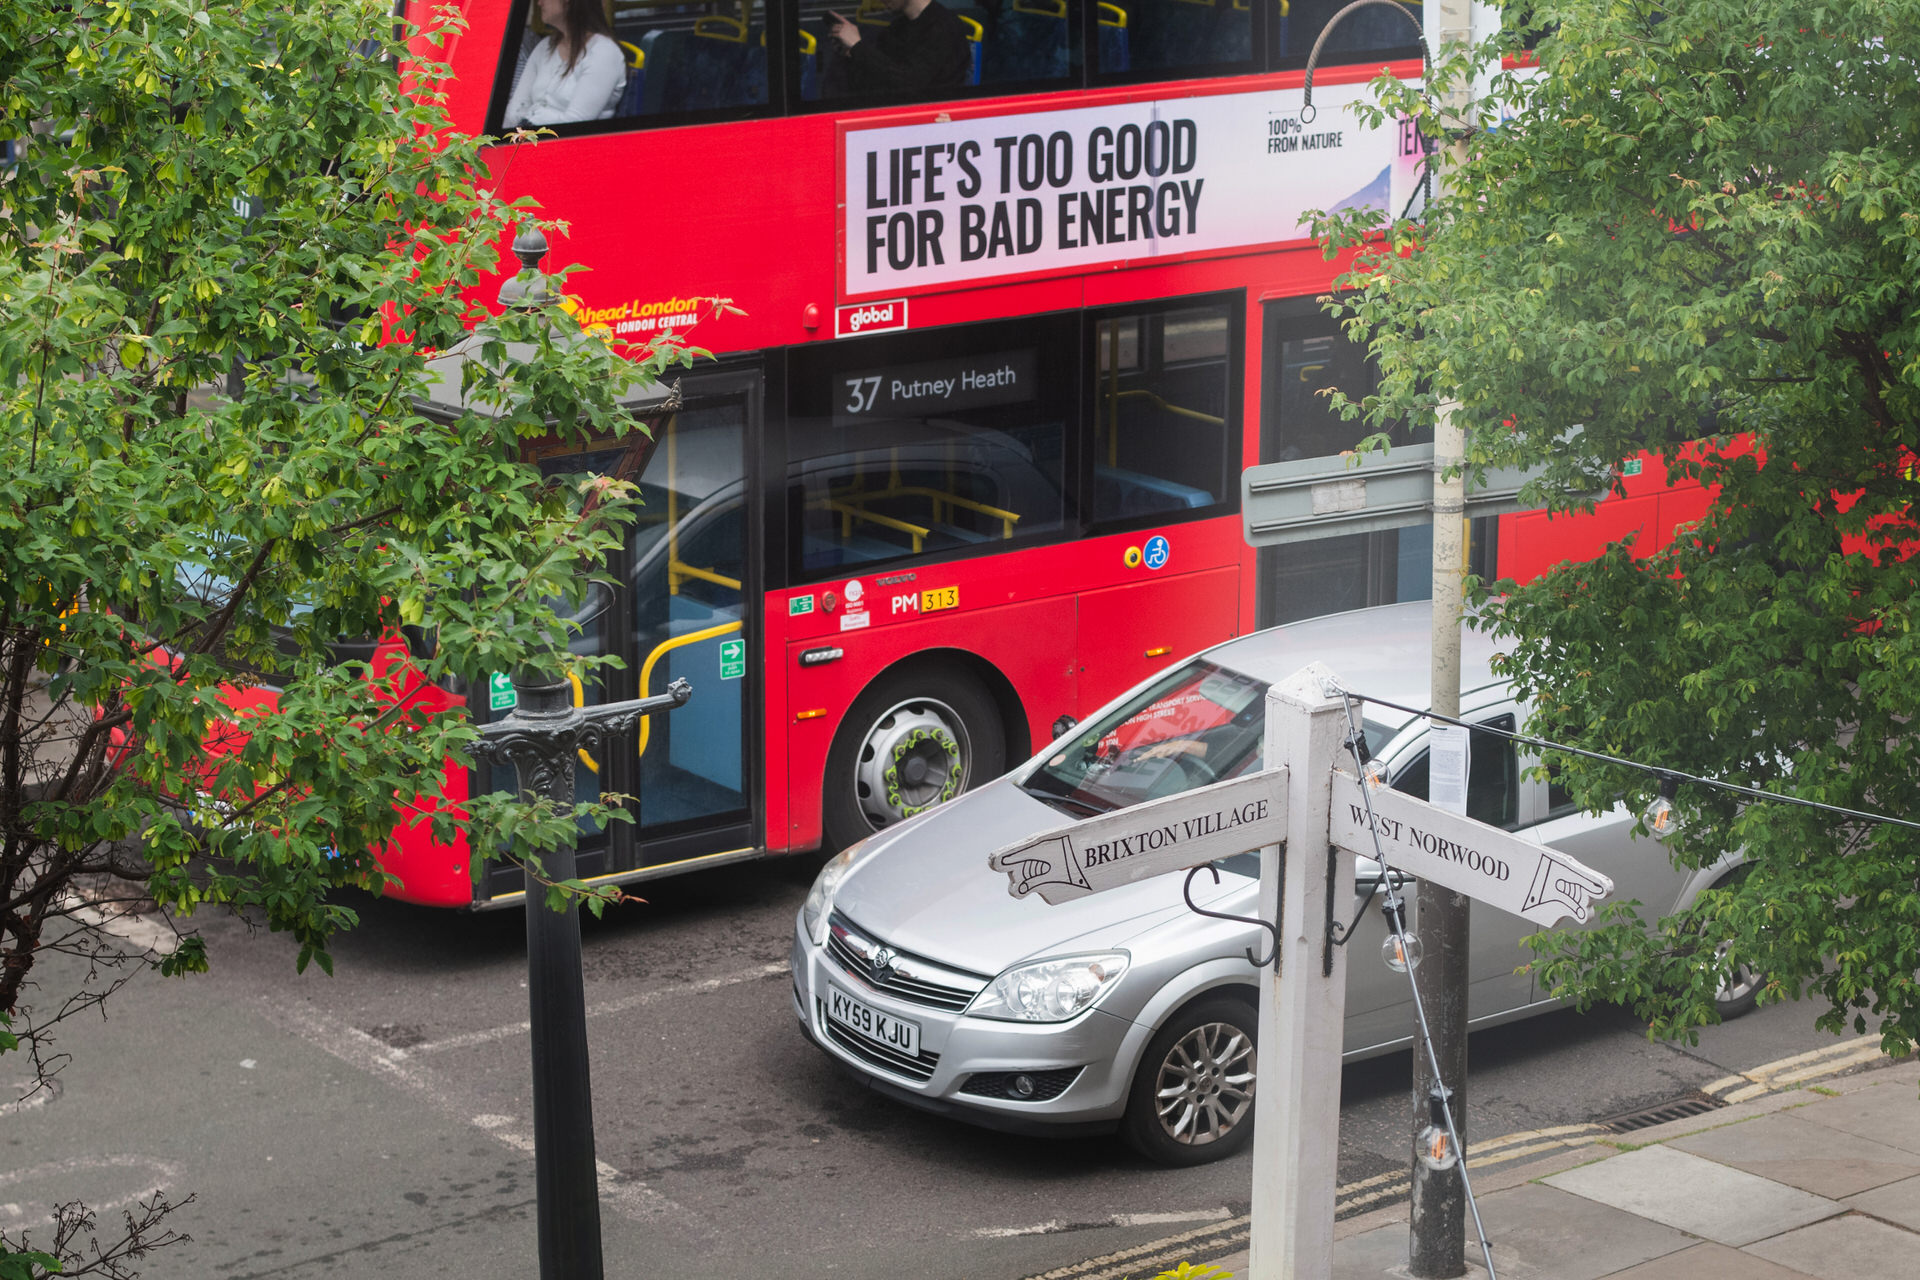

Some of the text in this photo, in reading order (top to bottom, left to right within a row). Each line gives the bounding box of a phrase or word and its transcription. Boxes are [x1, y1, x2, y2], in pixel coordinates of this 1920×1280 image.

[1268, 118, 1302, 136] 100%
[1268, 131, 1343, 154] FROM NATURE
[866, 118, 1197, 210] LIFE'S TOO GOOD
[866, 178, 1205, 274] FOR BAD ENERGY
[616, 313, 698, 334] LONDON CENTRAL
[850, 304, 893, 331] global
[846, 365, 1016, 413] 37 Putney Heath
[876, 573, 917, 587] VOLVO
[891, 590, 955, 614] PM 313
[1084, 799, 1269, 869] BRIXTON VILLAGE
[1348, 803, 1511, 881] WEST NORWOOD
[833, 991, 910, 1049] KY59 KJU
